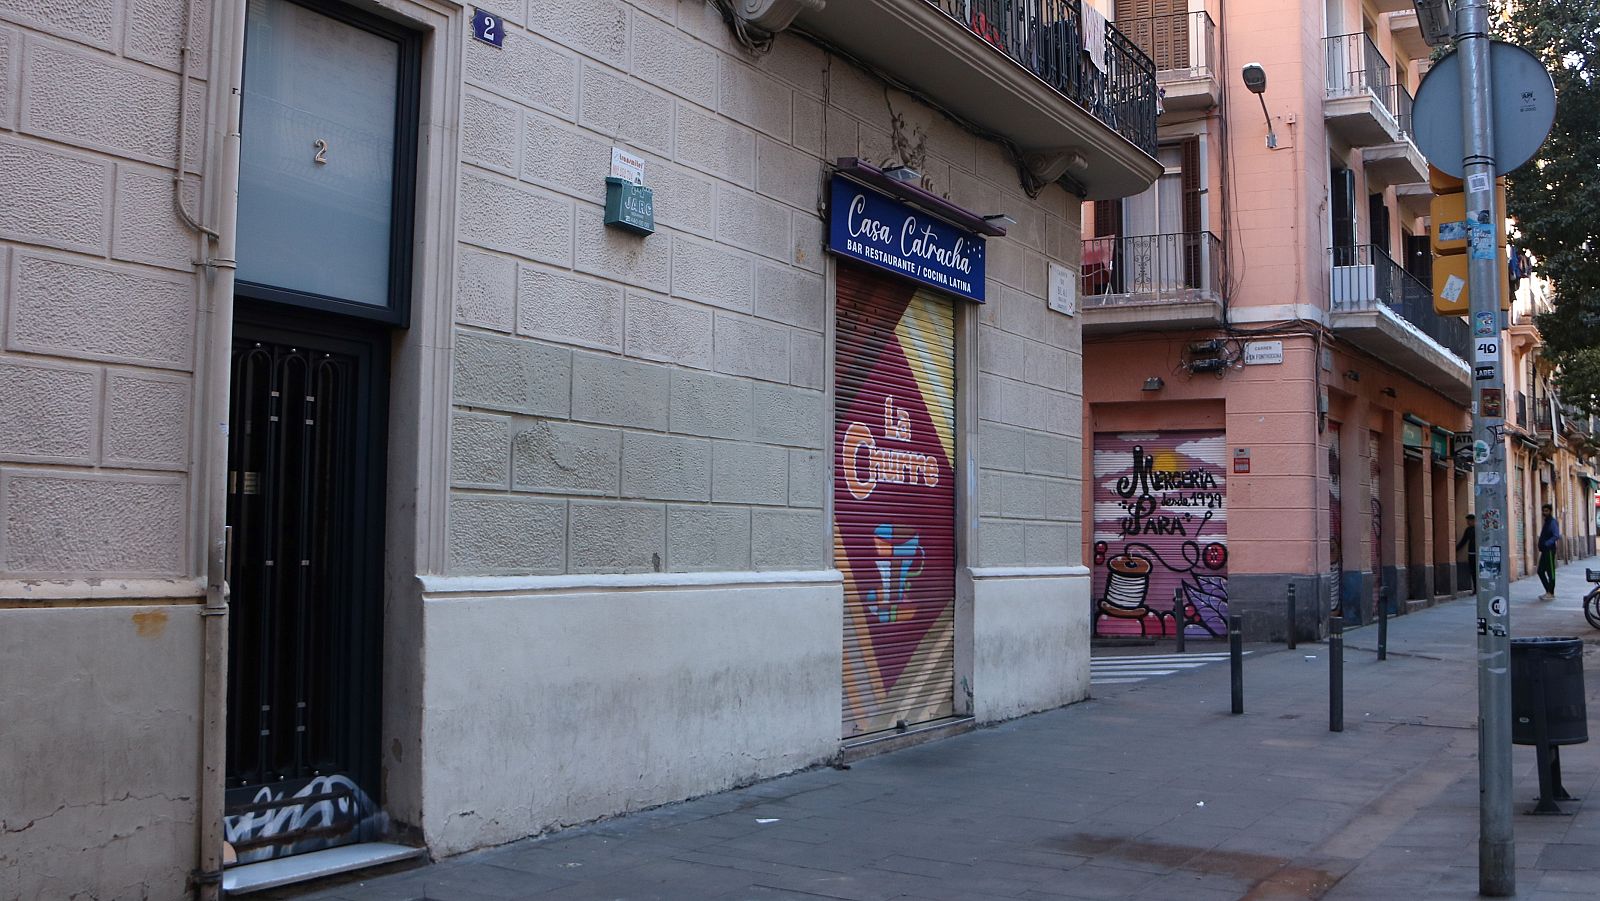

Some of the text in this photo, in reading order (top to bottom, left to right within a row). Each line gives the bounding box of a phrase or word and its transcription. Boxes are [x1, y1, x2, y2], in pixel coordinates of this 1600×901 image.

[484, 16, 495, 41] 2
[315, 139, 327, 164] 2
[847, 194, 972, 275] Casa Catracha
[847, 239, 972, 293] BAR RESTAURANTE / COCINA LATINA
[884, 395, 911, 442] La
